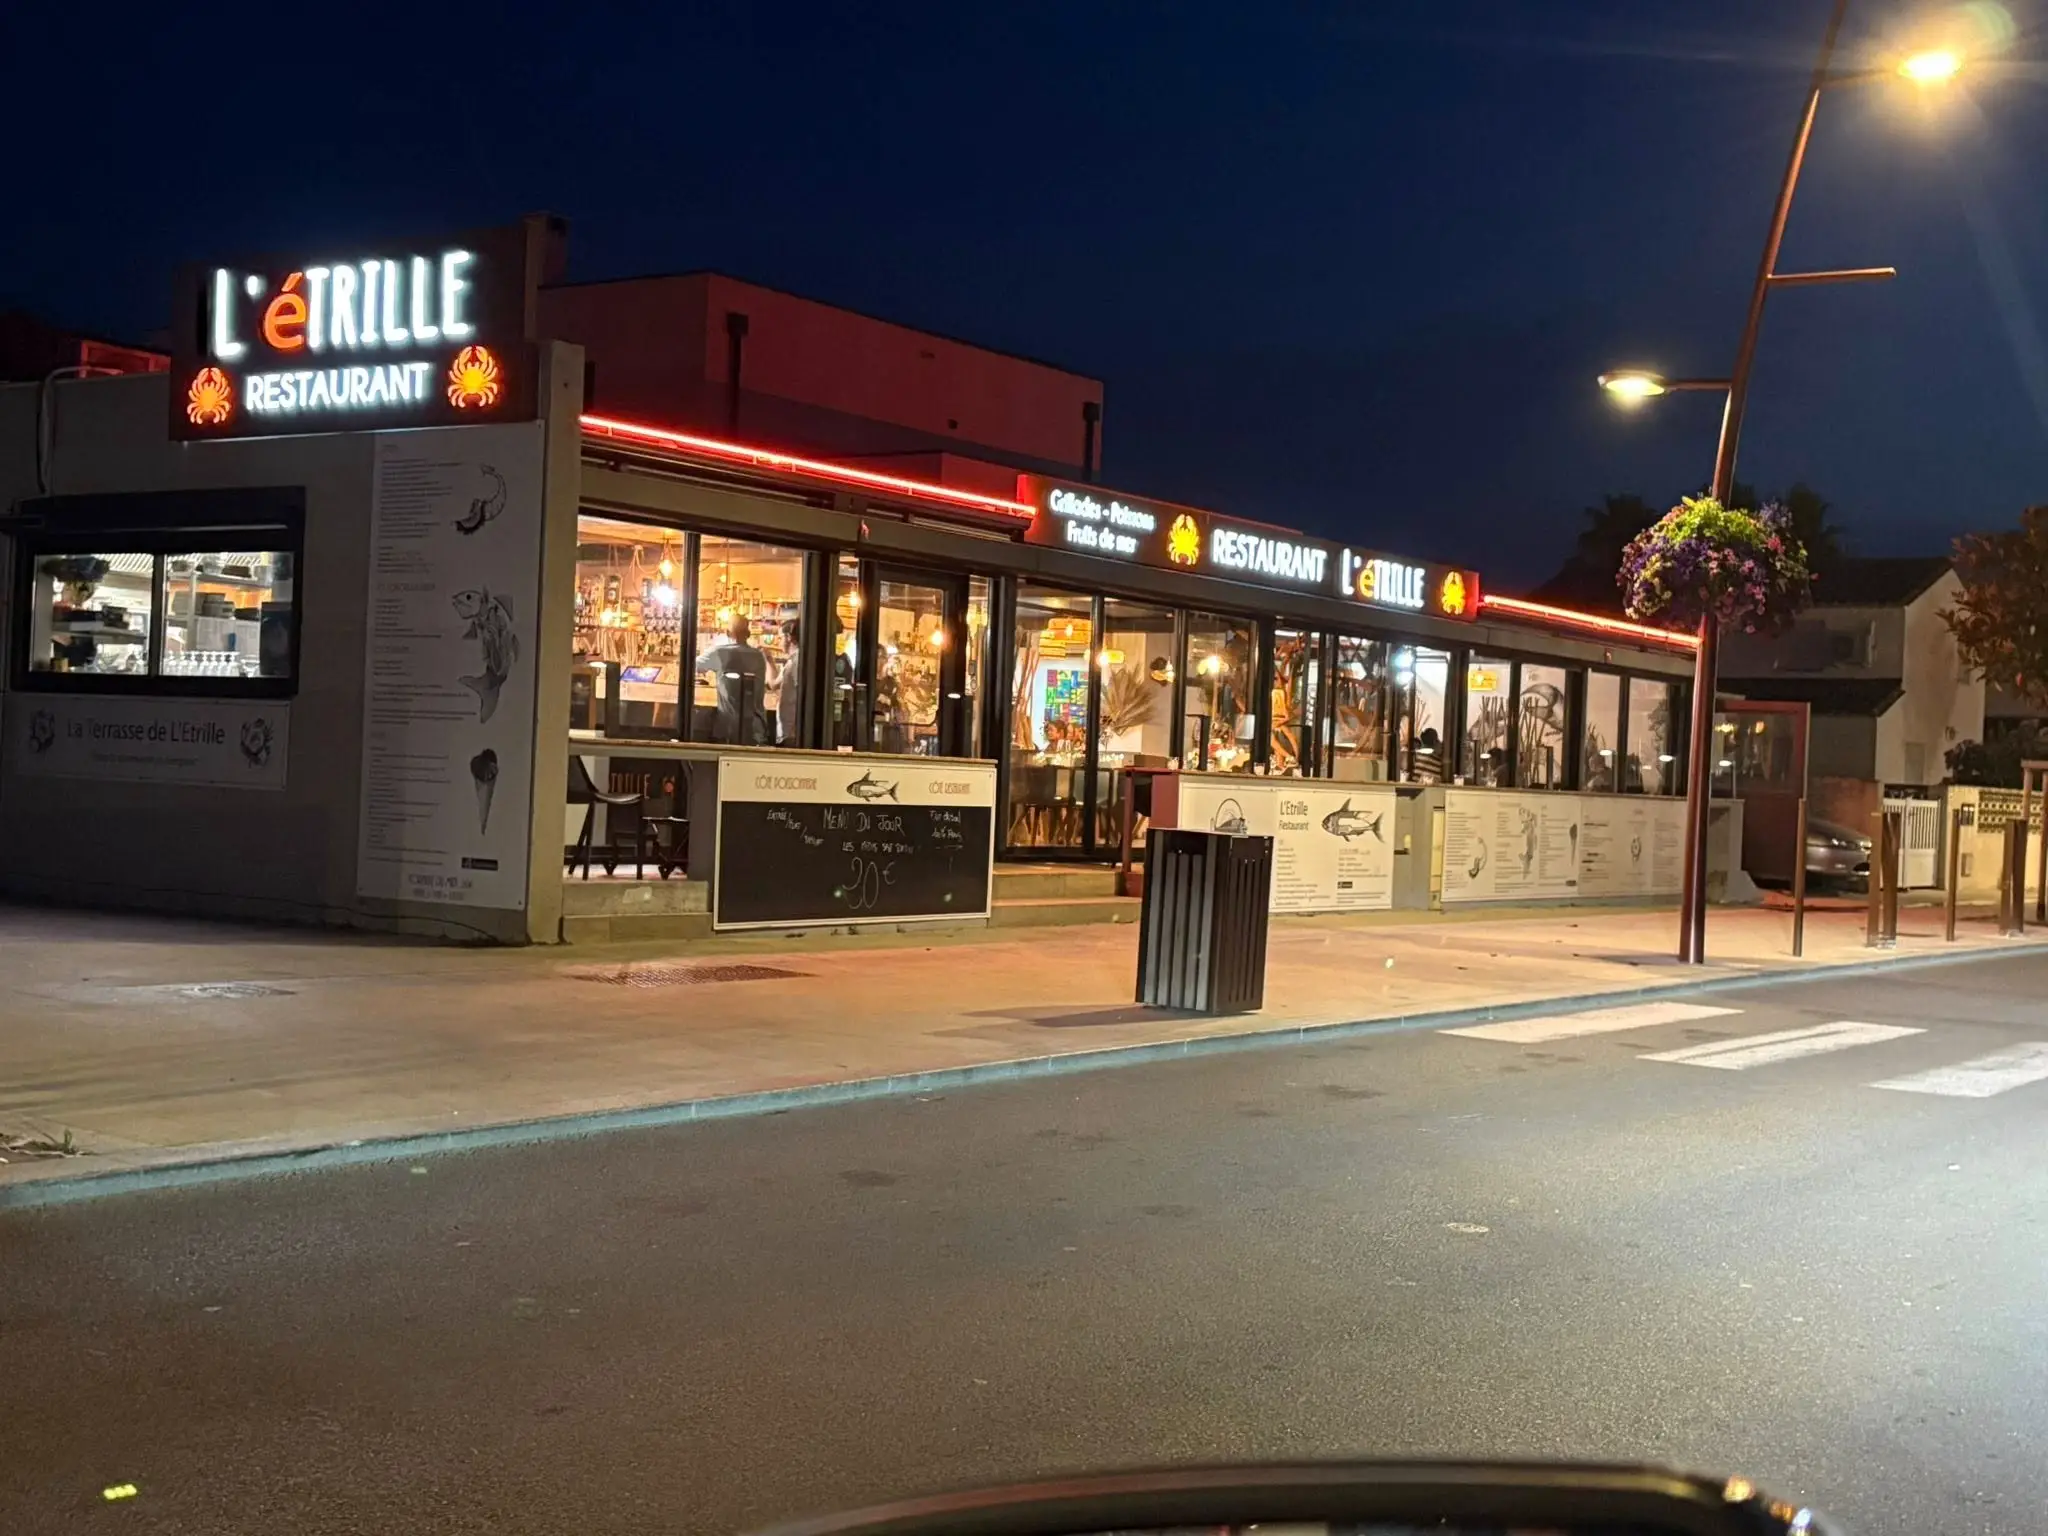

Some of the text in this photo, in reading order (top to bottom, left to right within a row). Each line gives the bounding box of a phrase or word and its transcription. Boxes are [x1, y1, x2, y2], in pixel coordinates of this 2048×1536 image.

[245, 362, 430, 410] RESTAURANT
[1050, 489, 1101, 520] Grillades
[1110, 501, 1155, 532] Poissons
[1067, 520, 1137, 553] Fruits de mer
[1211, 528, 1328, 582] RESTAURANT
[66, 717, 226, 745] La Terrasse de L'Etrille
[1280, 800, 1309, 816] L'Etrille
[876, 814, 906, 836] JOUR
[1278, 820, 1309, 831] Restaurant
